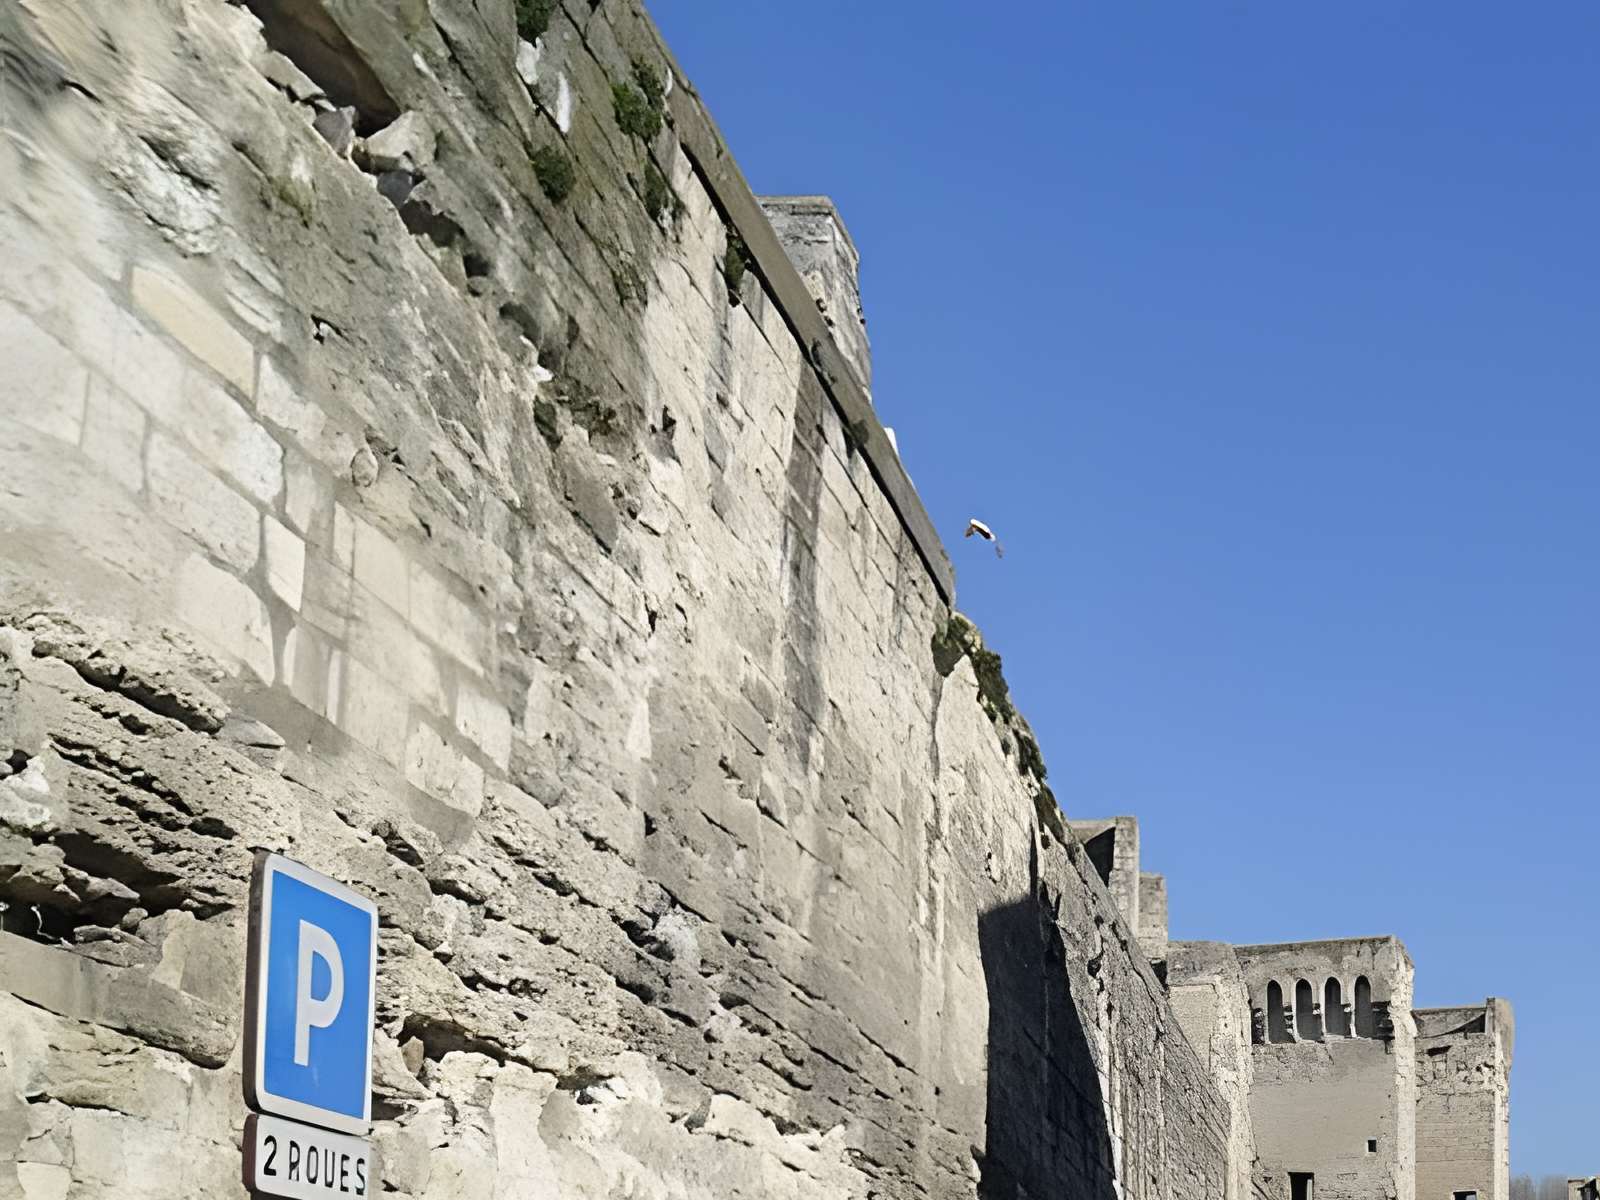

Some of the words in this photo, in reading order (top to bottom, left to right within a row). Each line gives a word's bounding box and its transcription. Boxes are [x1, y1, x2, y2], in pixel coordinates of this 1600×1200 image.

[294, 919, 344, 1066] P
[263, 1135, 277, 1176] 2
[289, 1139, 366, 1196] ROUES
